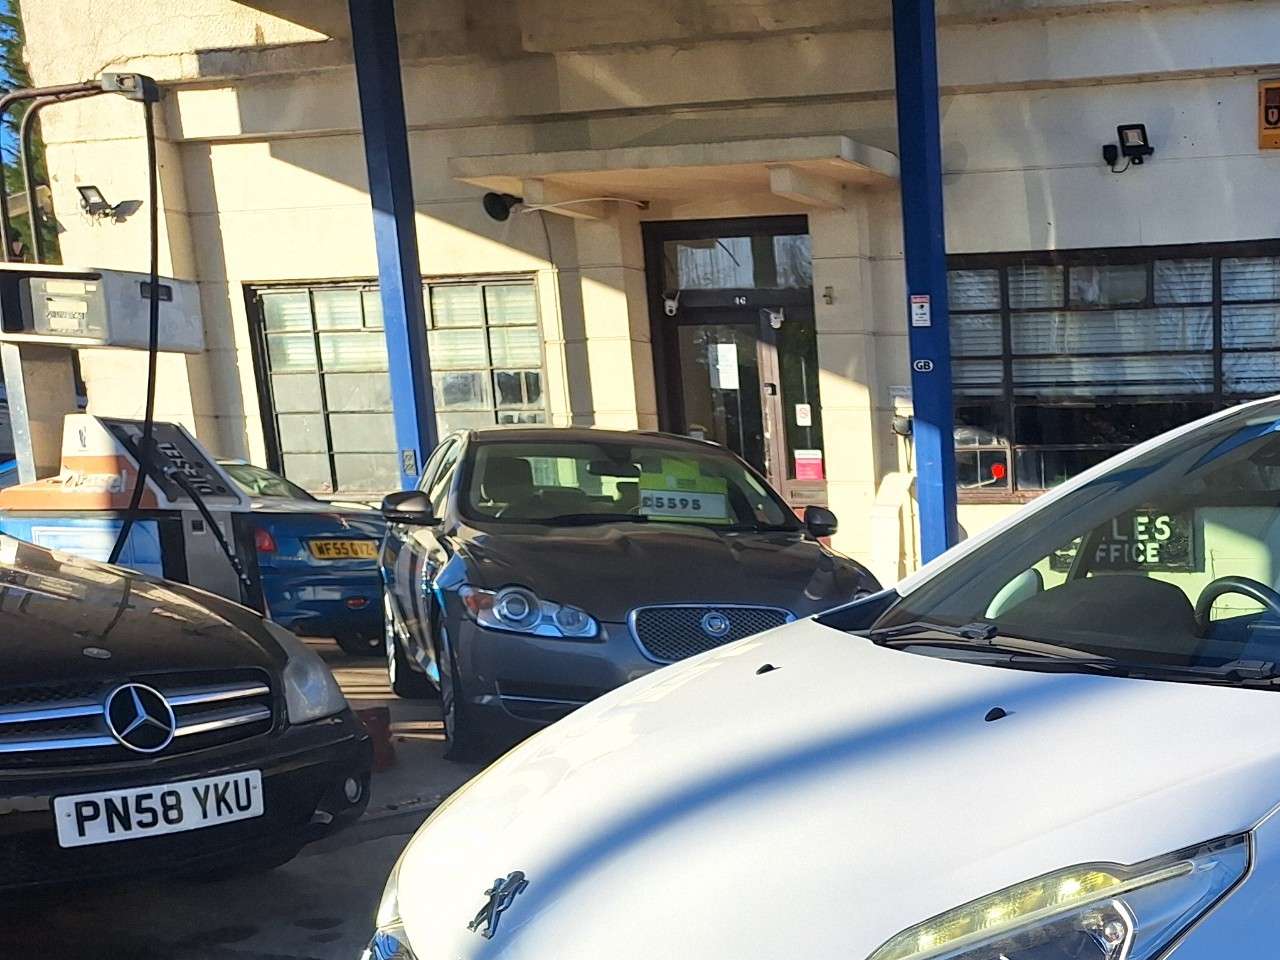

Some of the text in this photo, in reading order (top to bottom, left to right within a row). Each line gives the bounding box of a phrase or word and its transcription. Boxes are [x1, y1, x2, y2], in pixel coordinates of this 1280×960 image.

[915, 360, 932, 371] GB
[1101, 515, 1172, 542] LES
[1095, 541, 1161, 563] FFICE
[74, 777, 252, 838] PN58 YKU
